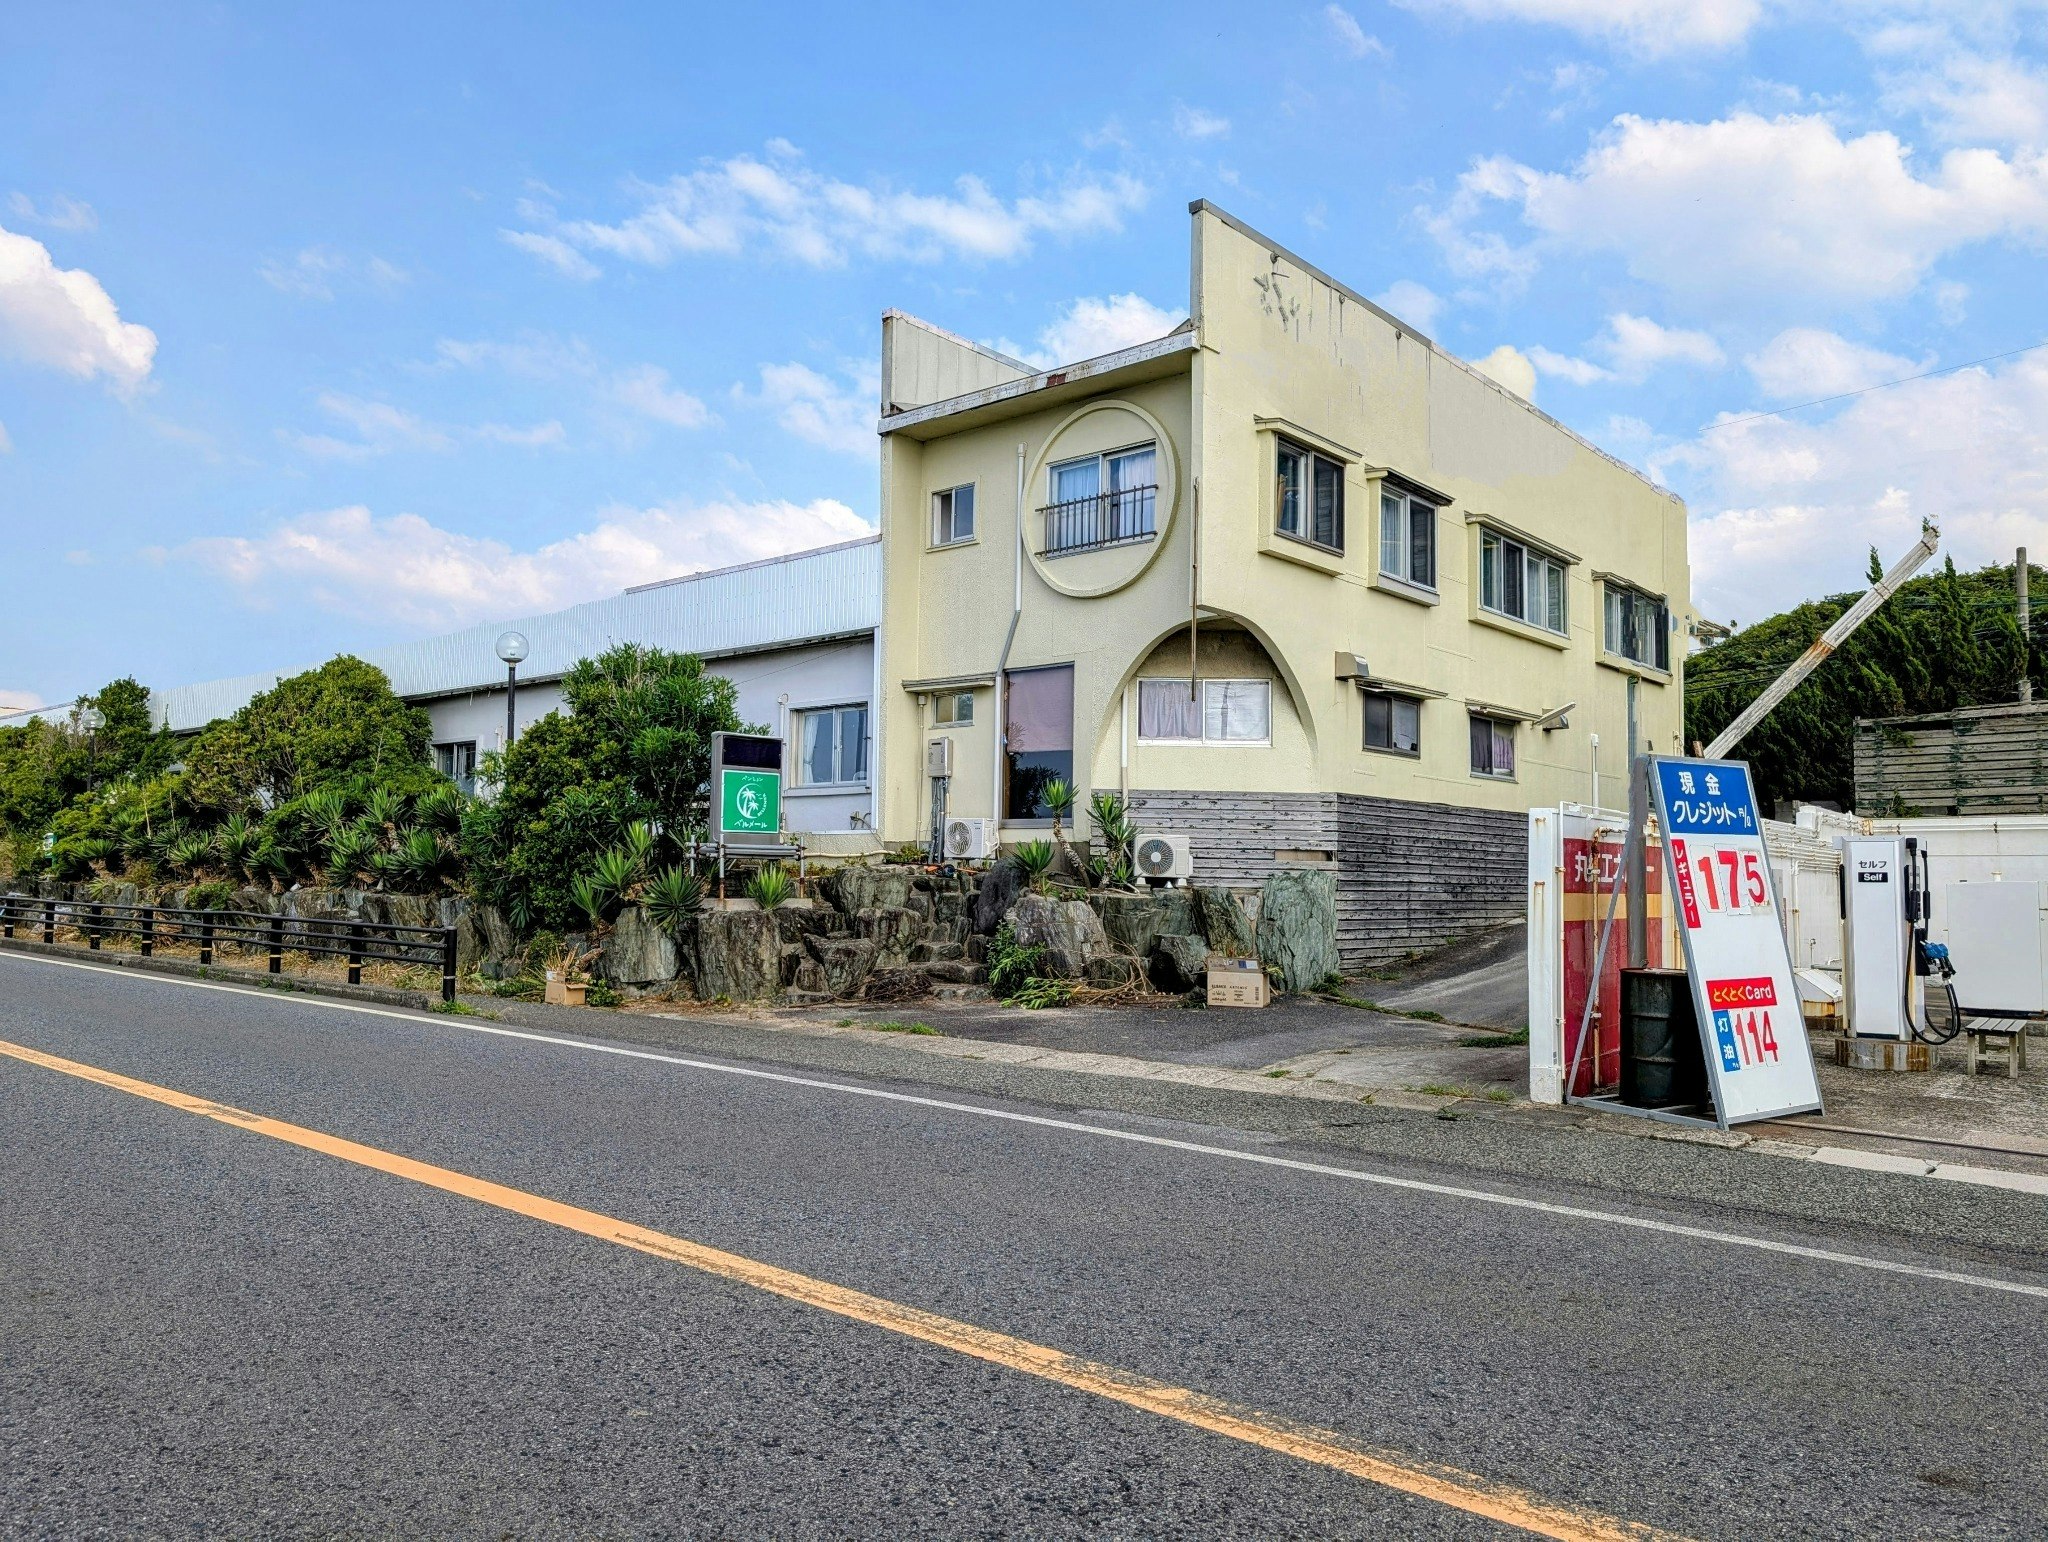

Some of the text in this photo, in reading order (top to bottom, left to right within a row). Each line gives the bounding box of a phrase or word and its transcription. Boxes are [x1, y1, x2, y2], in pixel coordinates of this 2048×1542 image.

[1679, 771, 1721, 795] 現金
[1673, 800, 1737, 825] クレジット
[1858, 860, 1888, 869] セルフ
[1863, 872, 1883, 881] Self
[1697, 850, 1765, 910] 175
[1713, 985, 1772, 1002] とくとくCard
[1718, 1017, 1736, 1060] 灯油
[1735, 1010, 1779, 1066] 114
